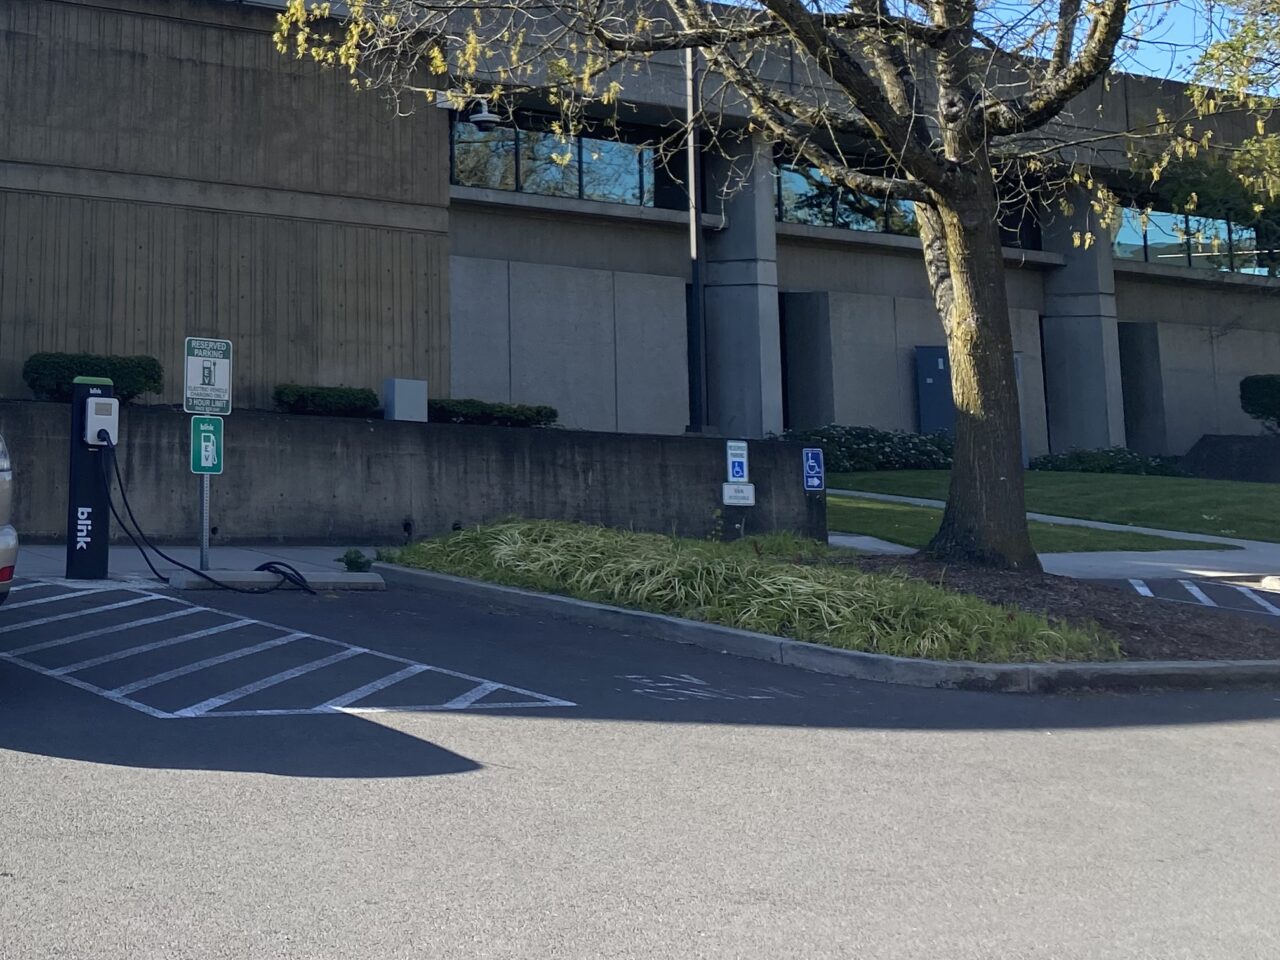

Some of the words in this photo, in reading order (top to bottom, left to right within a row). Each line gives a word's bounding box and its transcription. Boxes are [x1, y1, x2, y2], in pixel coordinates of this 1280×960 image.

[191, 340, 227, 351] RESERVED
[194, 348, 224, 358] PARKING
[188, 398, 193, 406] 3
[193, 399, 210, 407] HOUR
[211, 400, 227, 408] LIMIT
[204, 445, 210, 462] EV
[77, 507, 92, 550] blink
